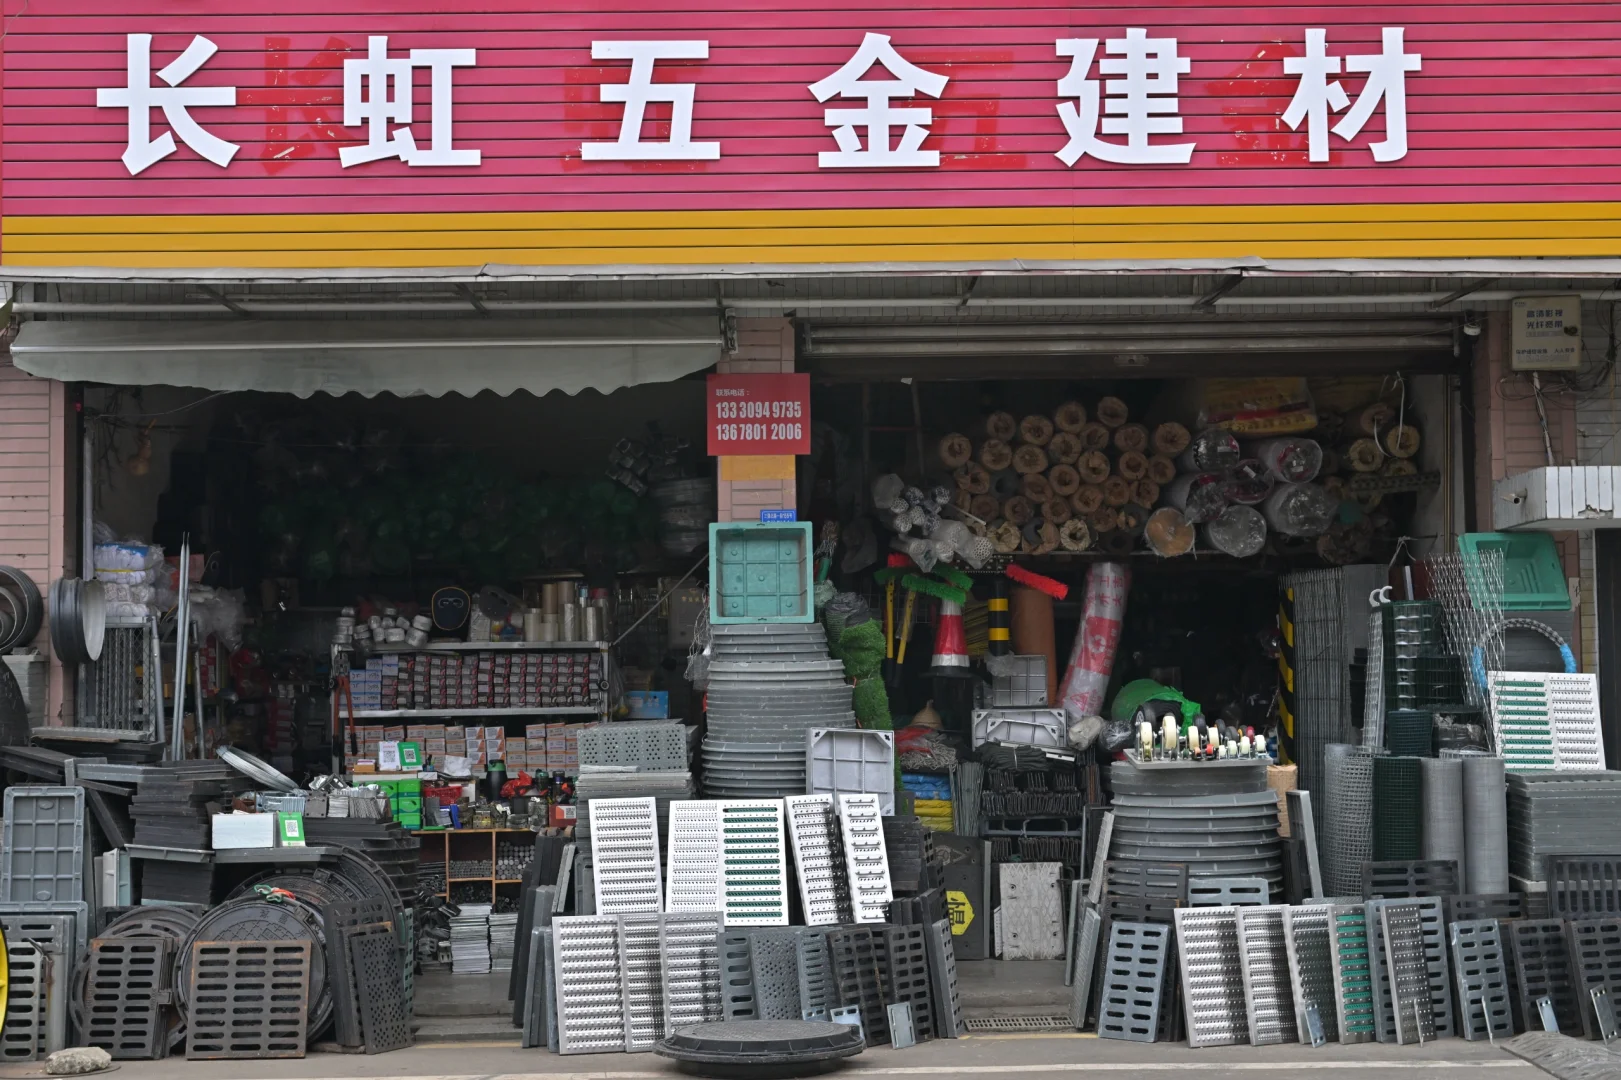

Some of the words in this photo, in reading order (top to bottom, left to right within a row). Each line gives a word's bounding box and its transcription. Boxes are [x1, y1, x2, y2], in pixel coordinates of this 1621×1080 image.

[97, 28, 1421, 175] 长虹五金建材
[1526, 320, 1562, 328] 光纤宽带
[715, 402, 737, 418] 133
[739, 401, 770, 418] 3094
[772, 401, 802, 418] 9735
[715, 423, 737, 440] 136
[739, 423, 767, 440] 7801
[771, 423, 802, 440] 2006
